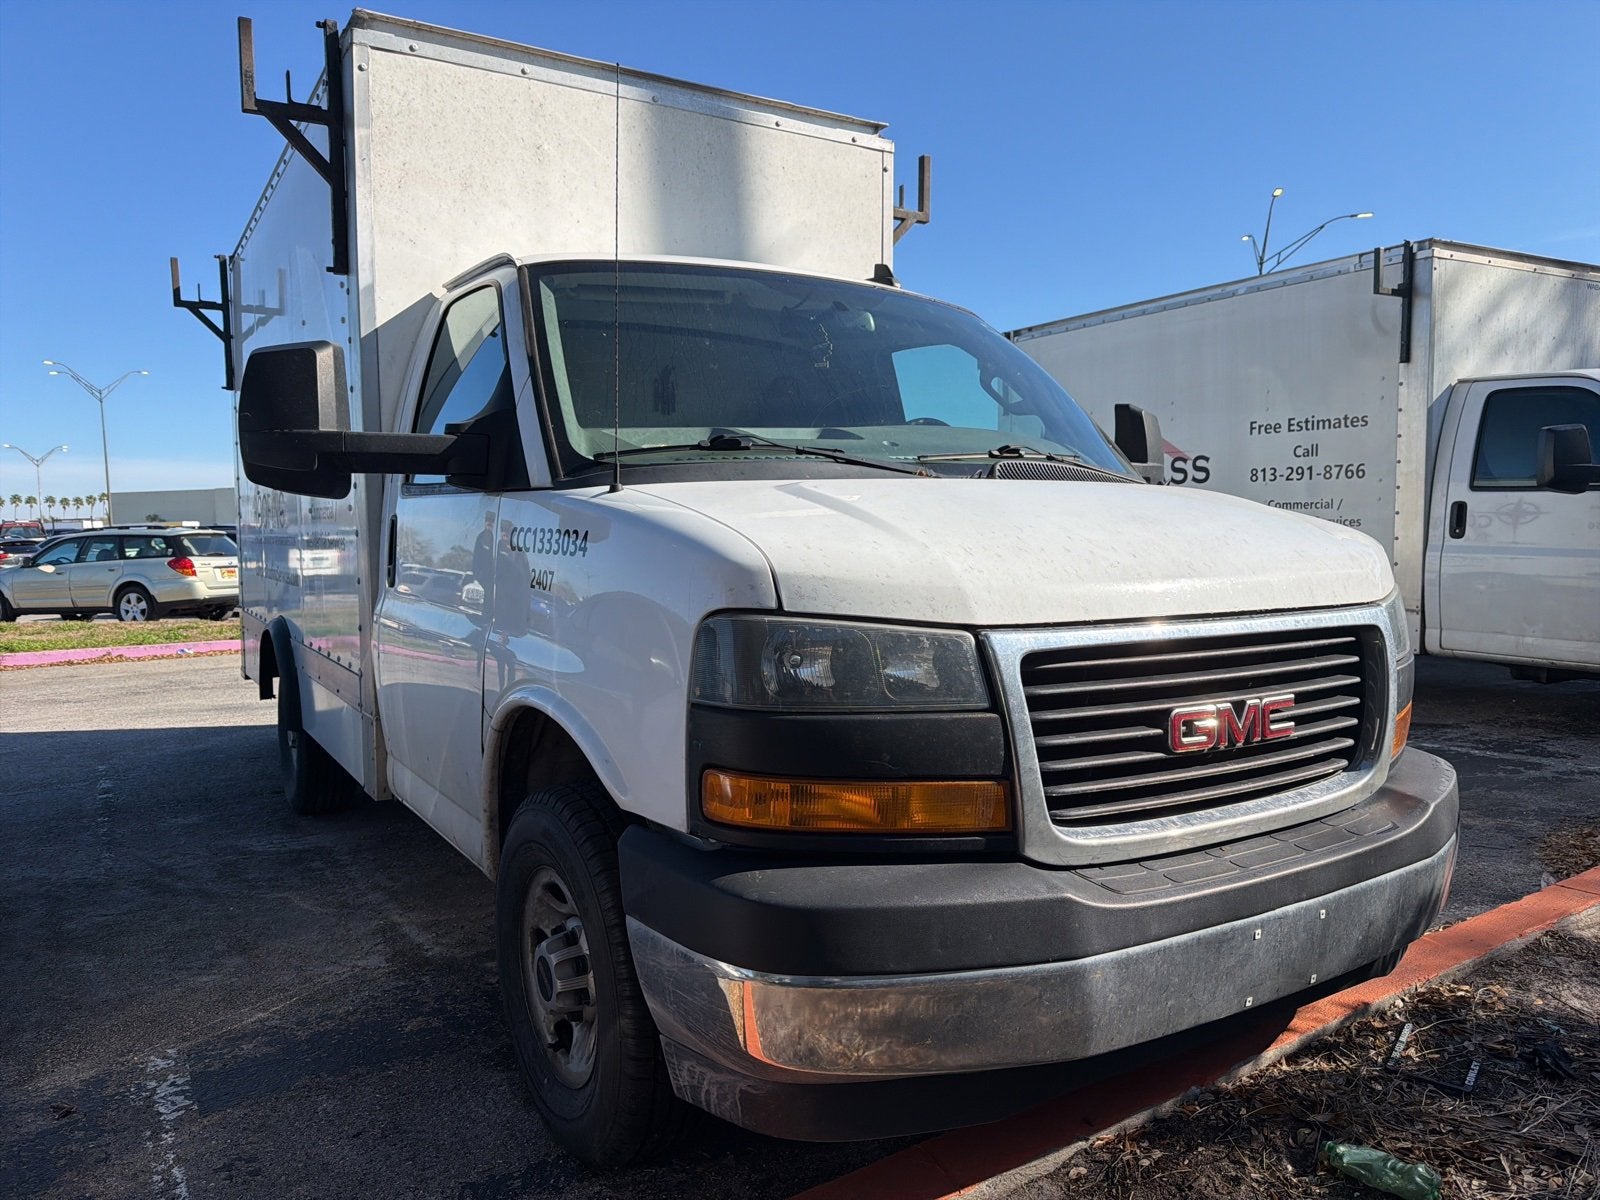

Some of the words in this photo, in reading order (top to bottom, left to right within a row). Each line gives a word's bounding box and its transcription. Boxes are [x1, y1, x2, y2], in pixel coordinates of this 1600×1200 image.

[1249, 421, 1282, 435] Free
[1287, 414, 1369, 432] Estimates
[1293, 443, 1319, 458] Call
[1170, 454, 1210, 484] SS
[1249, 463, 1366, 482] 813-291-8766
[509, 526, 589, 557] CCC1333034
[530, 568, 555, 591] 2407
[1168, 693, 1296, 752] GMC
